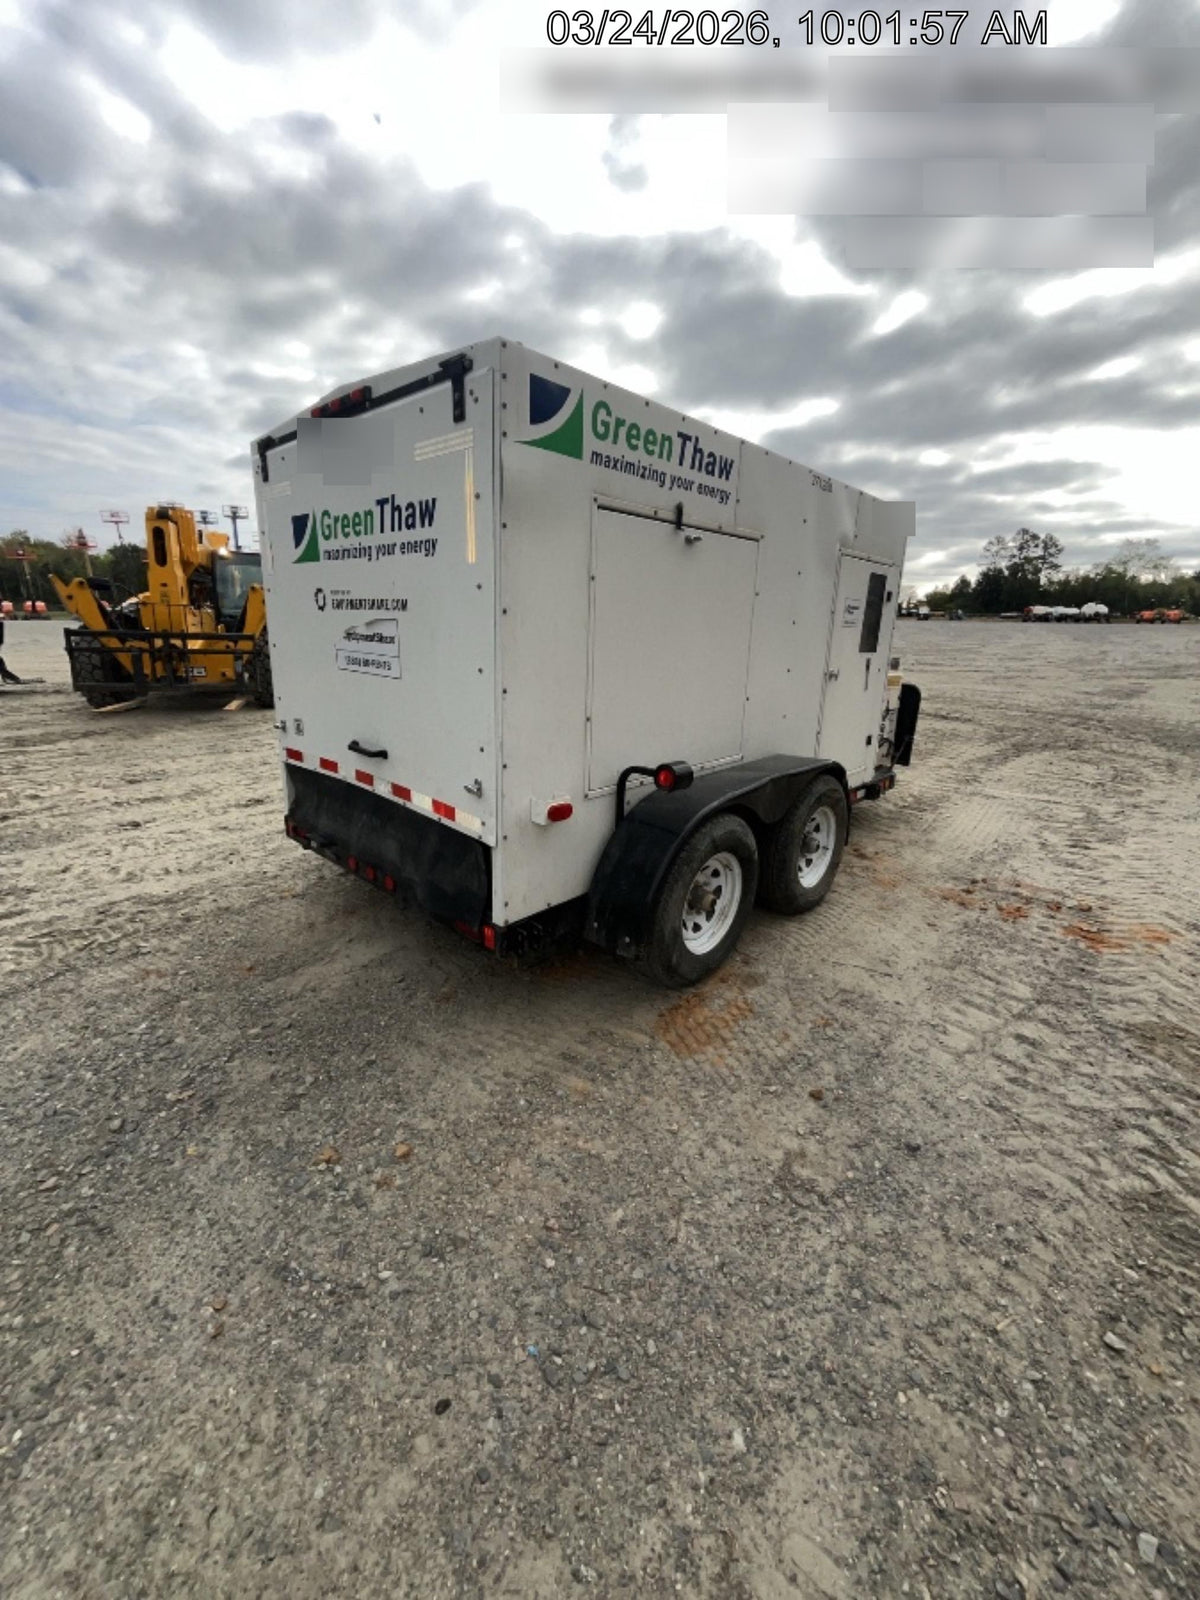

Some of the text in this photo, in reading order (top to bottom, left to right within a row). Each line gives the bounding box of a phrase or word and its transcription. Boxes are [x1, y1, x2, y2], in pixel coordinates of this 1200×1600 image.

[591, 399, 735, 481] GreenThaw
[590, 449, 732, 506] maximizing your energy
[320, 493, 438, 542] GreenThaw
[374, 541, 397, 561] your
[399, 537, 438, 557] energy
